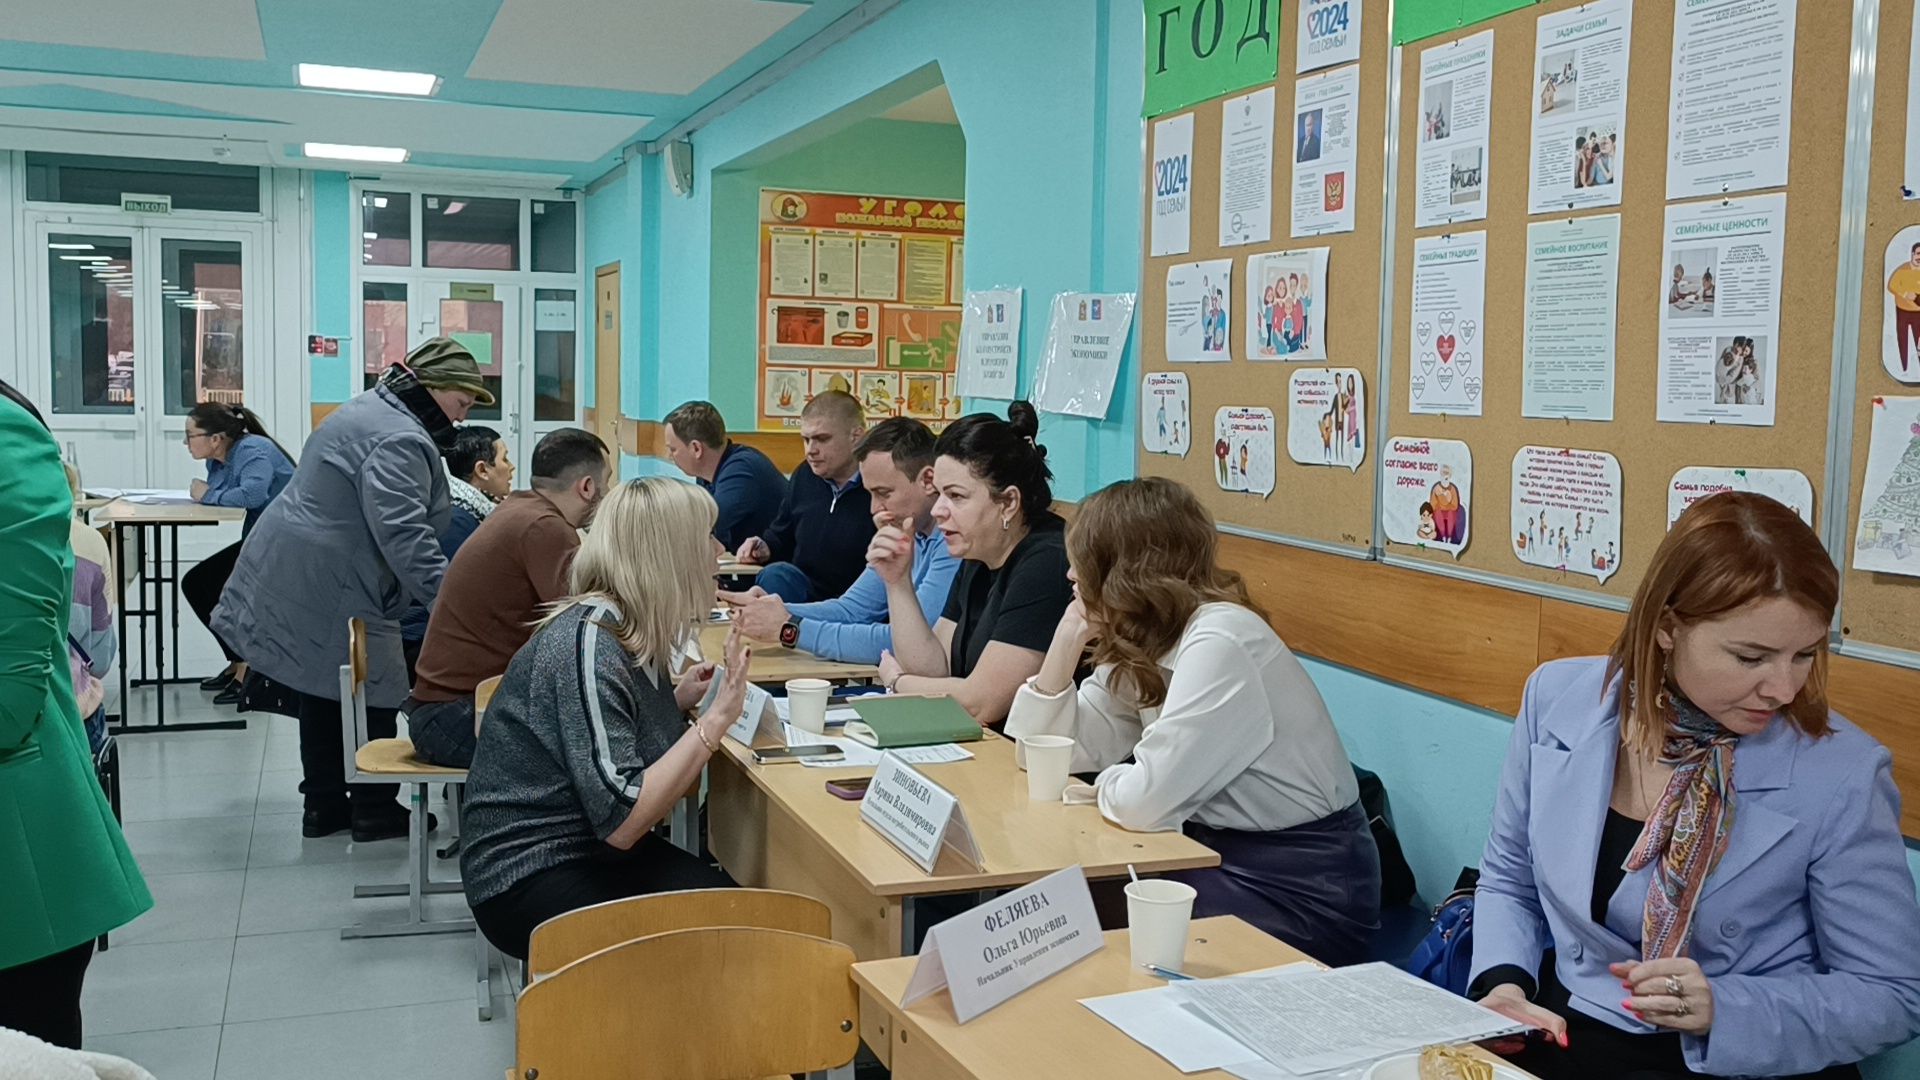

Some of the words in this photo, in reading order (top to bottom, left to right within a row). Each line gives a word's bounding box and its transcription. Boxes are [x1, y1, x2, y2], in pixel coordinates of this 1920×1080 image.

[1156, 0, 1270, 73] ГОД
[1307, 1, 1349, 40] 2024
[1155, 154, 1188, 196] 2024
[125, 201, 168, 213] ВЫХОД
[1675, 222, 1720, 236] СЕМЕЙНЫЕ
[1722, 217, 1768, 233] ЦЕННОСТИ
[1384, 459, 1418, 470] согласие
[1419, 461, 1439, 472] всего
[1674, 481, 1698, 491] Семья
[1700, 484, 1733, 493] подобна
[892, 768, 931, 805] ЗИНОВЬЕВА
[873, 779, 893, 805] Марина
[893, 795, 937, 836] Владимировна
[984, 891, 1050, 933] ФЕЛЯЕВА
[976, 963, 1013, 987] Начальник
[1012, 946, 1050, 972] Управления
[1050, 929, 1080, 952] экономики
[983, 938, 1019, 965] Ольга
[1019, 913, 1068, 946] Юрьевна
